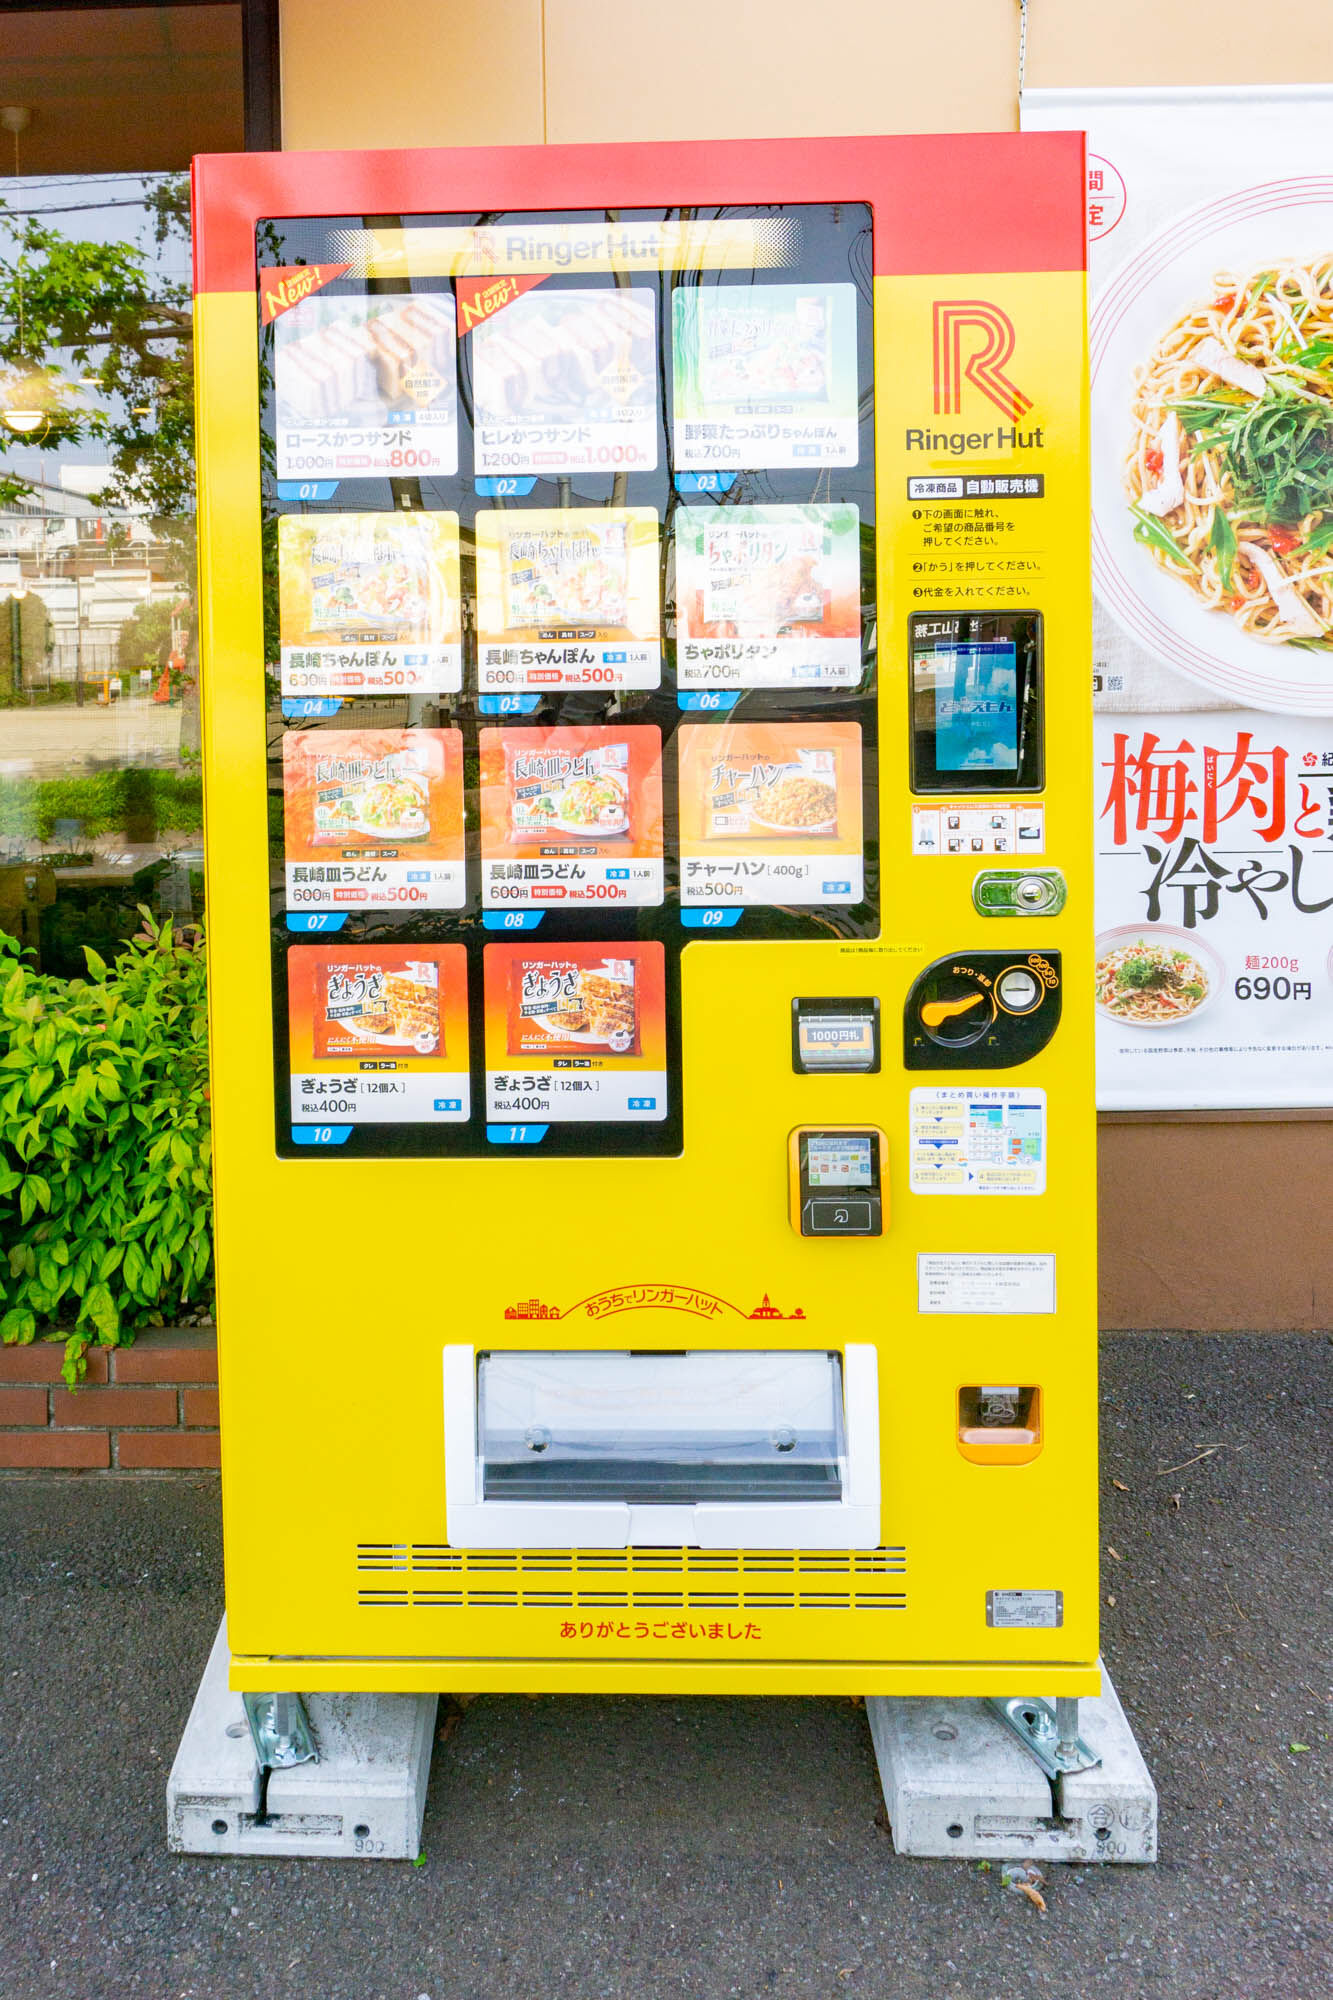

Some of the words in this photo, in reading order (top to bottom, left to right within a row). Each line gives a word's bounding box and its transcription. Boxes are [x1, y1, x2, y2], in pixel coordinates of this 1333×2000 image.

[506, 236, 602, 266] Ringer
[608, 234, 659, 259] Hut
[265, 267, 323, 317] New!
[461, 277, 519, 327] New!
[286, 430, 412, 448] ロースかつサンド
[481, 427, 592, 446] ヒレかつサンド
[685, 423, 837, 441] 野菜たっぷりちゃんぽん
[905, 428, 994, 456] Ringer
[997, 426, 1044, 450] Hut
[496, 479, 517, 494] 02
[697, 475, 717, 490] 03
[914, 482, 957, 494] 冷凍商品
[966, 478, 1039, 494] 自動販売機
[299, 484, 318, 498] 01
[923, 521, 1015, 533] ご希望の商品番号を
[923, 536, 998, 548] 押してください。
[289, 651, 397, 668] 長崎ちゃんぽん
[485, 648, 596, 666] 長崎ちゃんぽん
[485, 670, 525, 684] 600円
[303, 700, 323, 715] 04
[500, 697, 520, 712] 05
[700, 694, 720, 708] 06
[514, 756, 597, 779] 長崎皿うどん
[711, 763, 784, 791] チャーハン
[1099, 732, 1333, 846] 梅肉と
[292, 866, 387, 883] 長崎皿うどん
[490, 864, 586, 881] 長崎皿うどん
[608, 870, 626, 878] 冷凍
[686, 862, 766, 877] チャーハン
[687, 882, 743, 896] 税込500円
[1138, 837, 1333, 929] 冷やし
[293, 888, 331, 901] 600円
[490, 885, 528, 899] 600円
[569, 884, 627, 899] 税込500円
[307, 915, 328, 929] 07
[504, 913, 525, 928] 08
[703, 910, 723, 926] 09
[327, 964, 382, 973] リンガーハットの
[522, 961, 578, 969] リンガーハットの
[1245, 955, 1299, 972] 麺200g
[328, 974, 384, 1001] ぎょうざ
[523, 971, 579, 998] ぎょうざ
[1235, 976, 1312, 1001] 690円
[811, 1030, 861, 1042] 1000円札
[301, 1078, 358, 1094] ぎょうざ
[494, 1075, 552, 1092] ぎょうざ
[301, 1099, 357, 1113] 税込400円
[438, 1101, 457, 1109] 冷凍
[494, 1097, 550, 1111] 税込400円
[632, 1100, 651, 1108] 冷凍
[314, 1128, 332, 1142] 10
[509, 1127, 527, 1141] 11
[585, 1289, 724, 1318] おうちでリンガーハット
[559, 1621, 762, 1640] ありがとうございました
